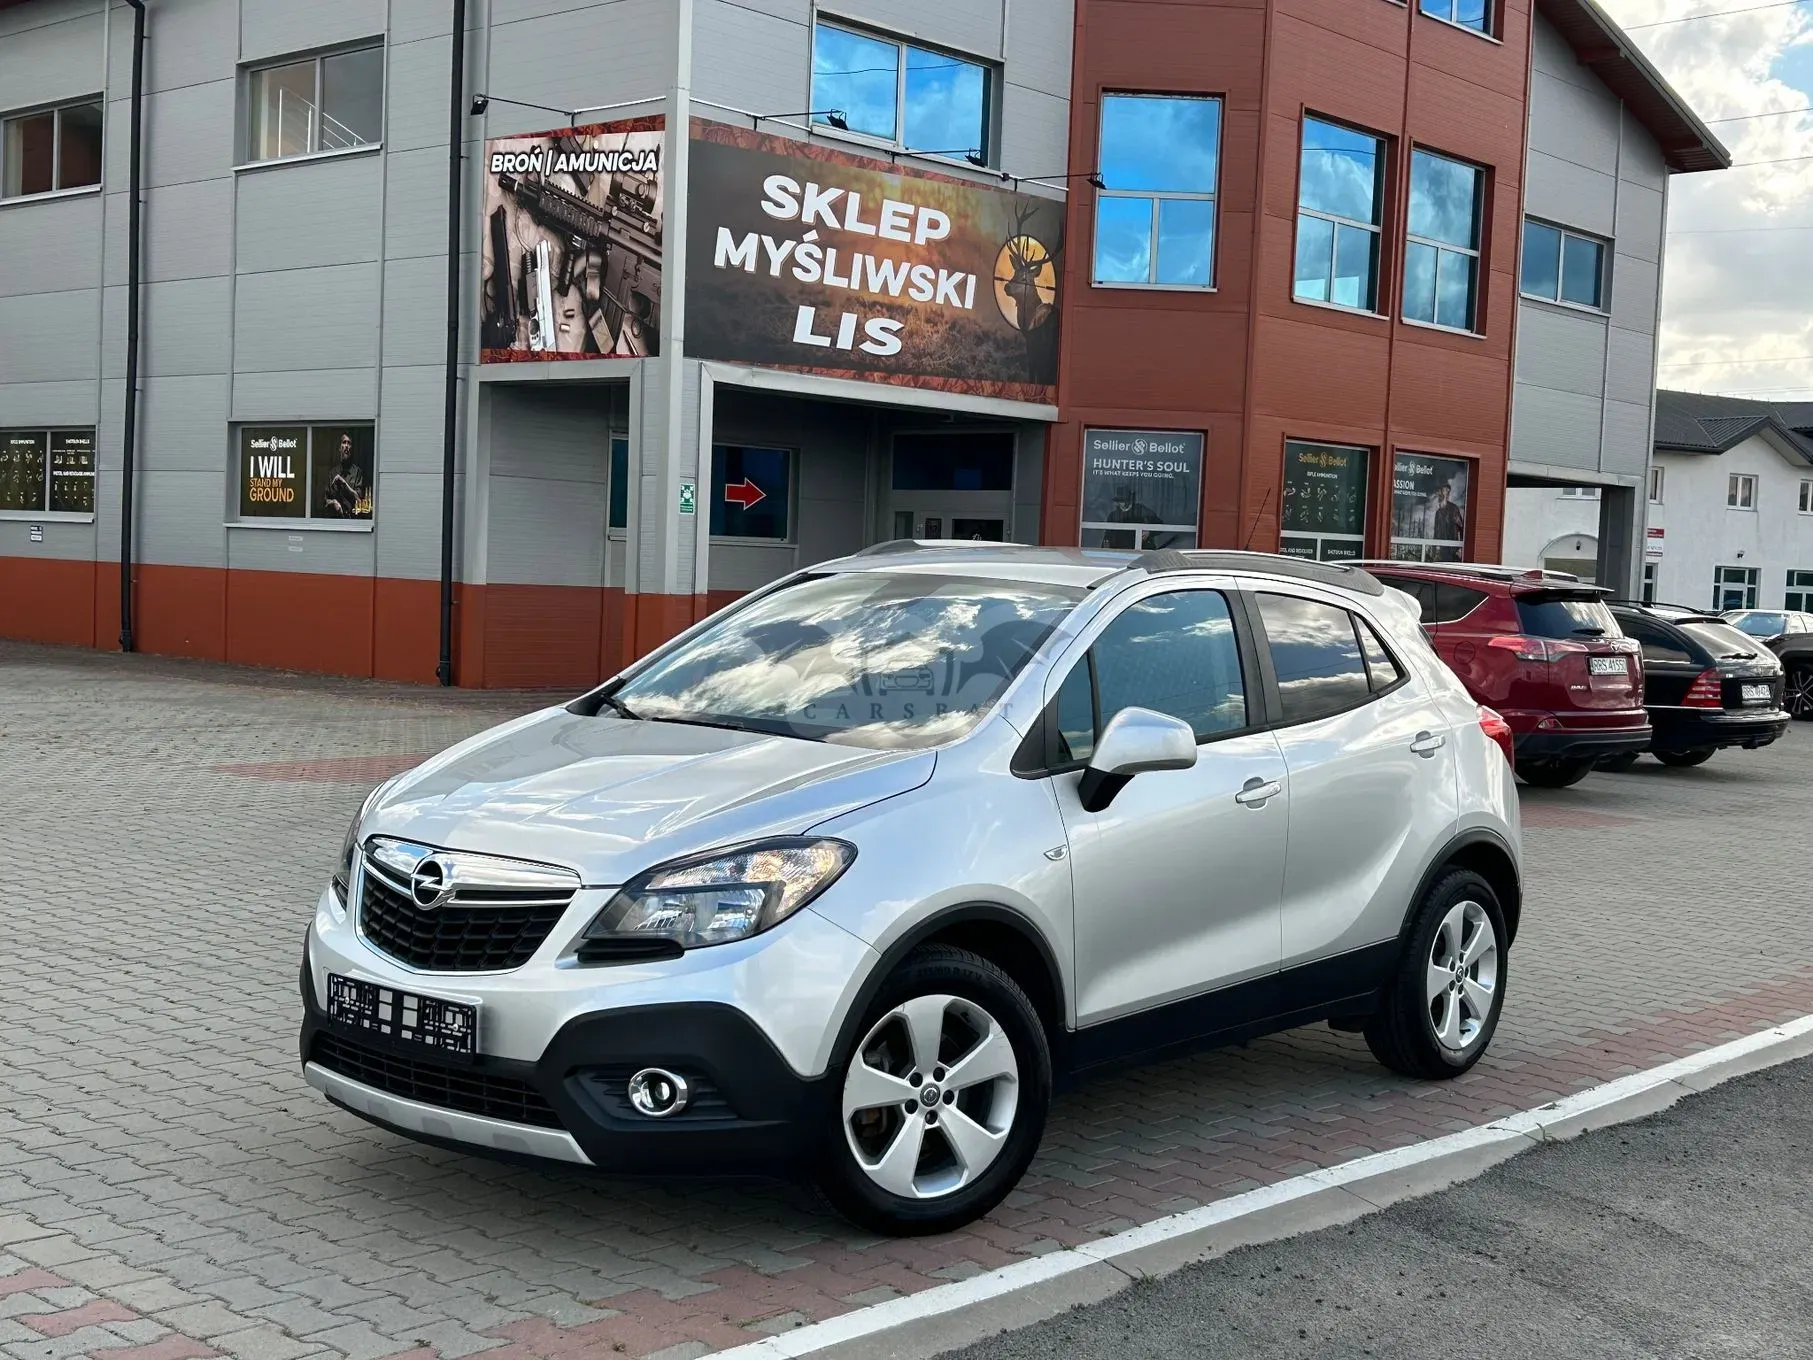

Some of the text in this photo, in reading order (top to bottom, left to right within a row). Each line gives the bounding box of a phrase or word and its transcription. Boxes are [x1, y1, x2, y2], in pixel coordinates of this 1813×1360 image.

[491, 148, 658, 173] BROŃ AMUNICJA
[760, 174, 951, 246] SKLEP
[713, 226, 977, 310] MYŚLIWSKI
[792, 305, 905, 356] LIS
[250, 438, 297, 448] Sellier Bellot
[1093, 439, 1185, 454] Sellier Bellot
[250, 456, 295, 478] I WILL
[1093, 459, 1190, 473] HUNTER'S SOUL
[250, 479, 282, 487] STAND MY
[250, 487, 294, 502] GROUND
